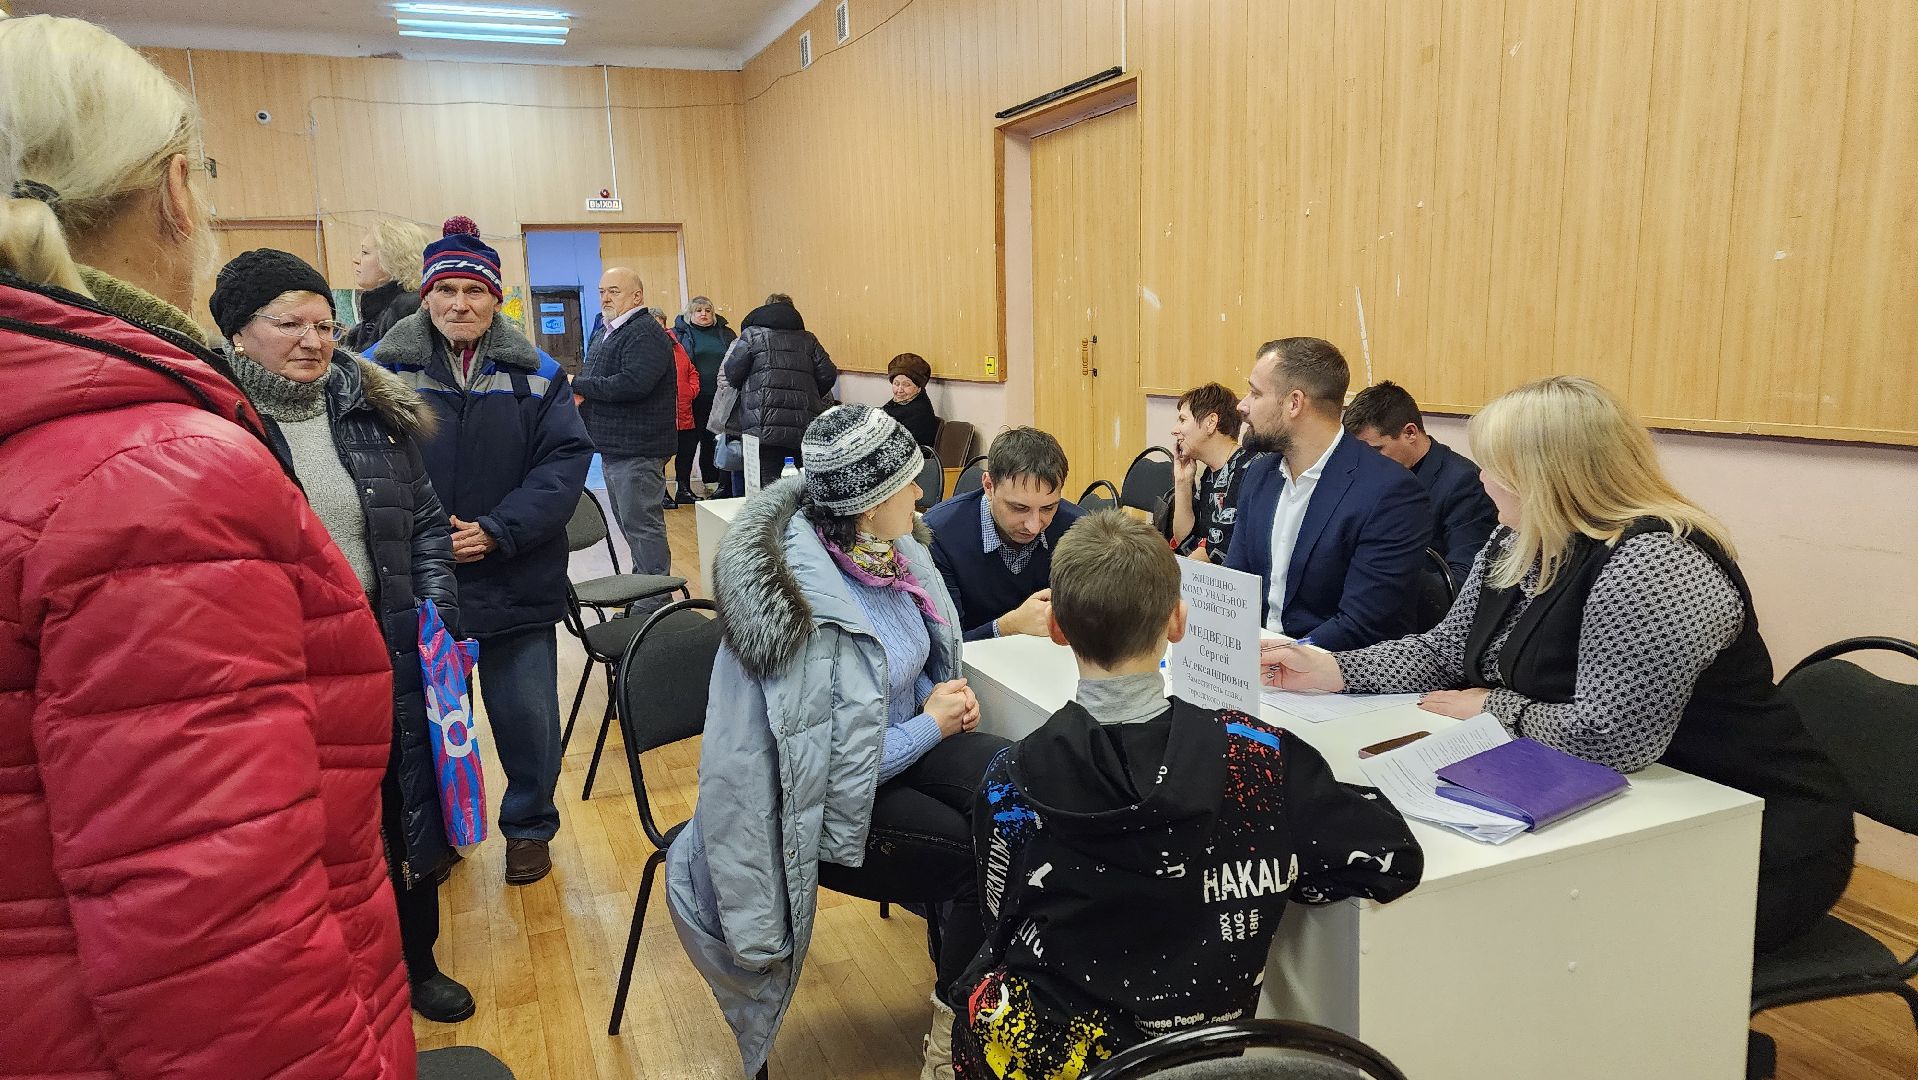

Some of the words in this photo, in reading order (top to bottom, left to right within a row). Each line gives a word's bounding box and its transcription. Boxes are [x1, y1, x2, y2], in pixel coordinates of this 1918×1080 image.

[589, 200, 619, 209] ВЫХОД
[1192, 572, 1237, 592] ЖИЛИЩНО-
[1191, 597, 1237, 619] ХОЗЯЙСТВО
[1188, 623, 1242, 651] МЕДВЕДЕВ
[1199, 644, 1230, 665] Сергей
[1182, 656, 1249, 690] Александрович
[1203, 853, 1299, 903] HAKALA
[1219, 912, 1234, 943] 20XX
[1233, 909, 1246, 940] AUG.
[1249, 908, 1259, 938] 18th
[1174, 1012, 1205, 1027] People
